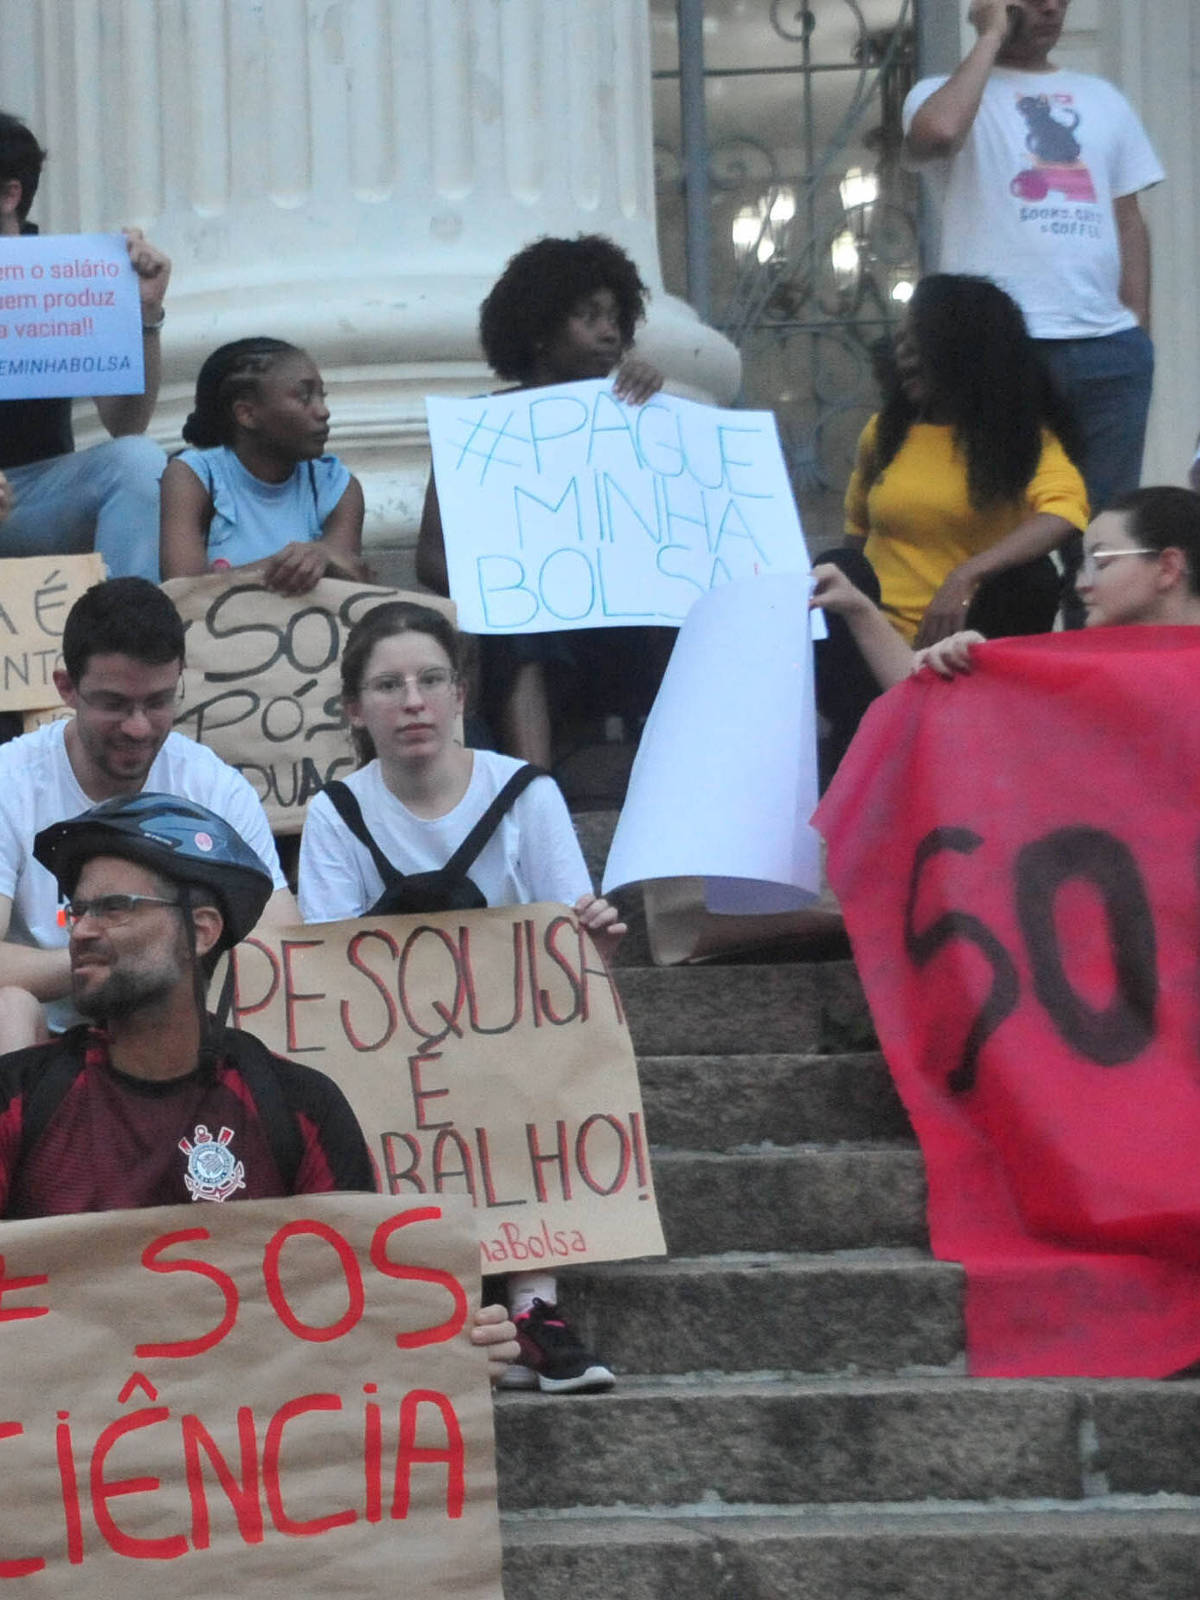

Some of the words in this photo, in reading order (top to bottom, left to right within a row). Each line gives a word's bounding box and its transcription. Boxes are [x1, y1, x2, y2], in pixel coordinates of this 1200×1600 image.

[31, 266, 44, 280] o
[51, 258, 120, 281] salário
[43, 288, 116, 312] produz
[14, 317, 94, 340] vacina!!
[514, 467, 772, 567] MINHA
[34, 569, 69, 638] É
[228, 916, 624, 1053] PESQUISA
[406, 1035, 455, 1130] É
[134, 1206, 468, 1359] SOS
